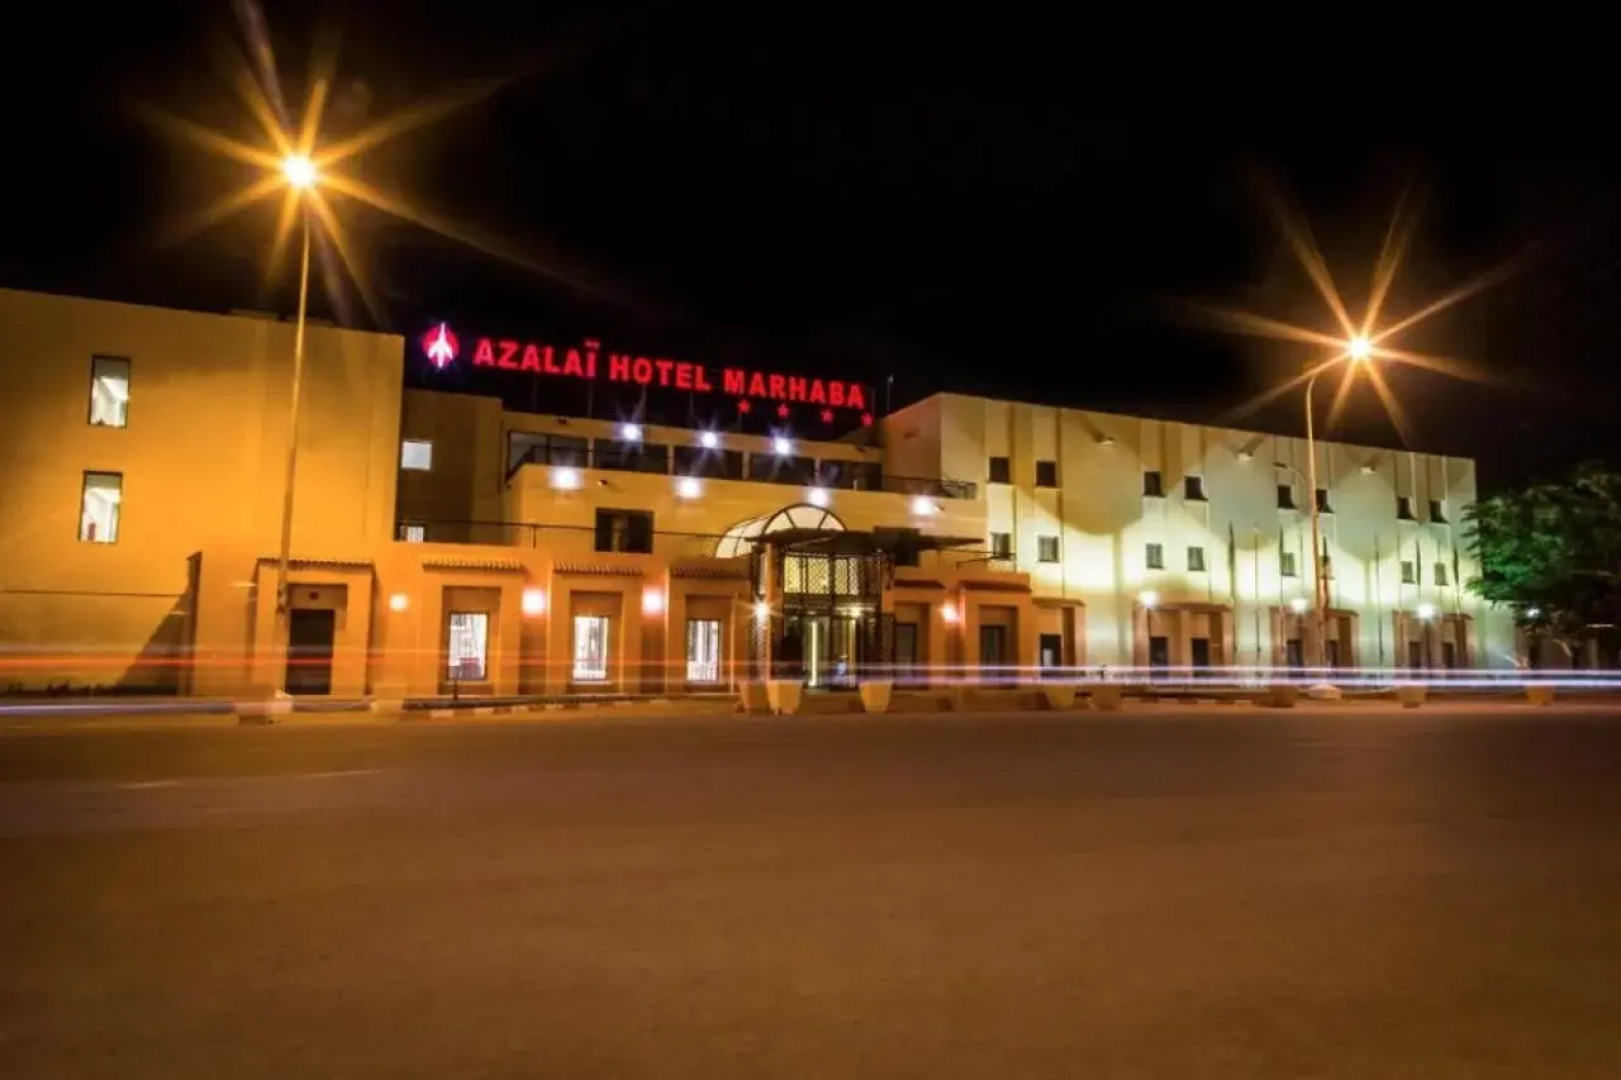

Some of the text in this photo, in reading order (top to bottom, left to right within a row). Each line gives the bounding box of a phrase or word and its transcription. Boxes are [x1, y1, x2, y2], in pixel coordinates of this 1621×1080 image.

[473, 339, 865, 409] AZALAÏ HOTEL MARHABA
